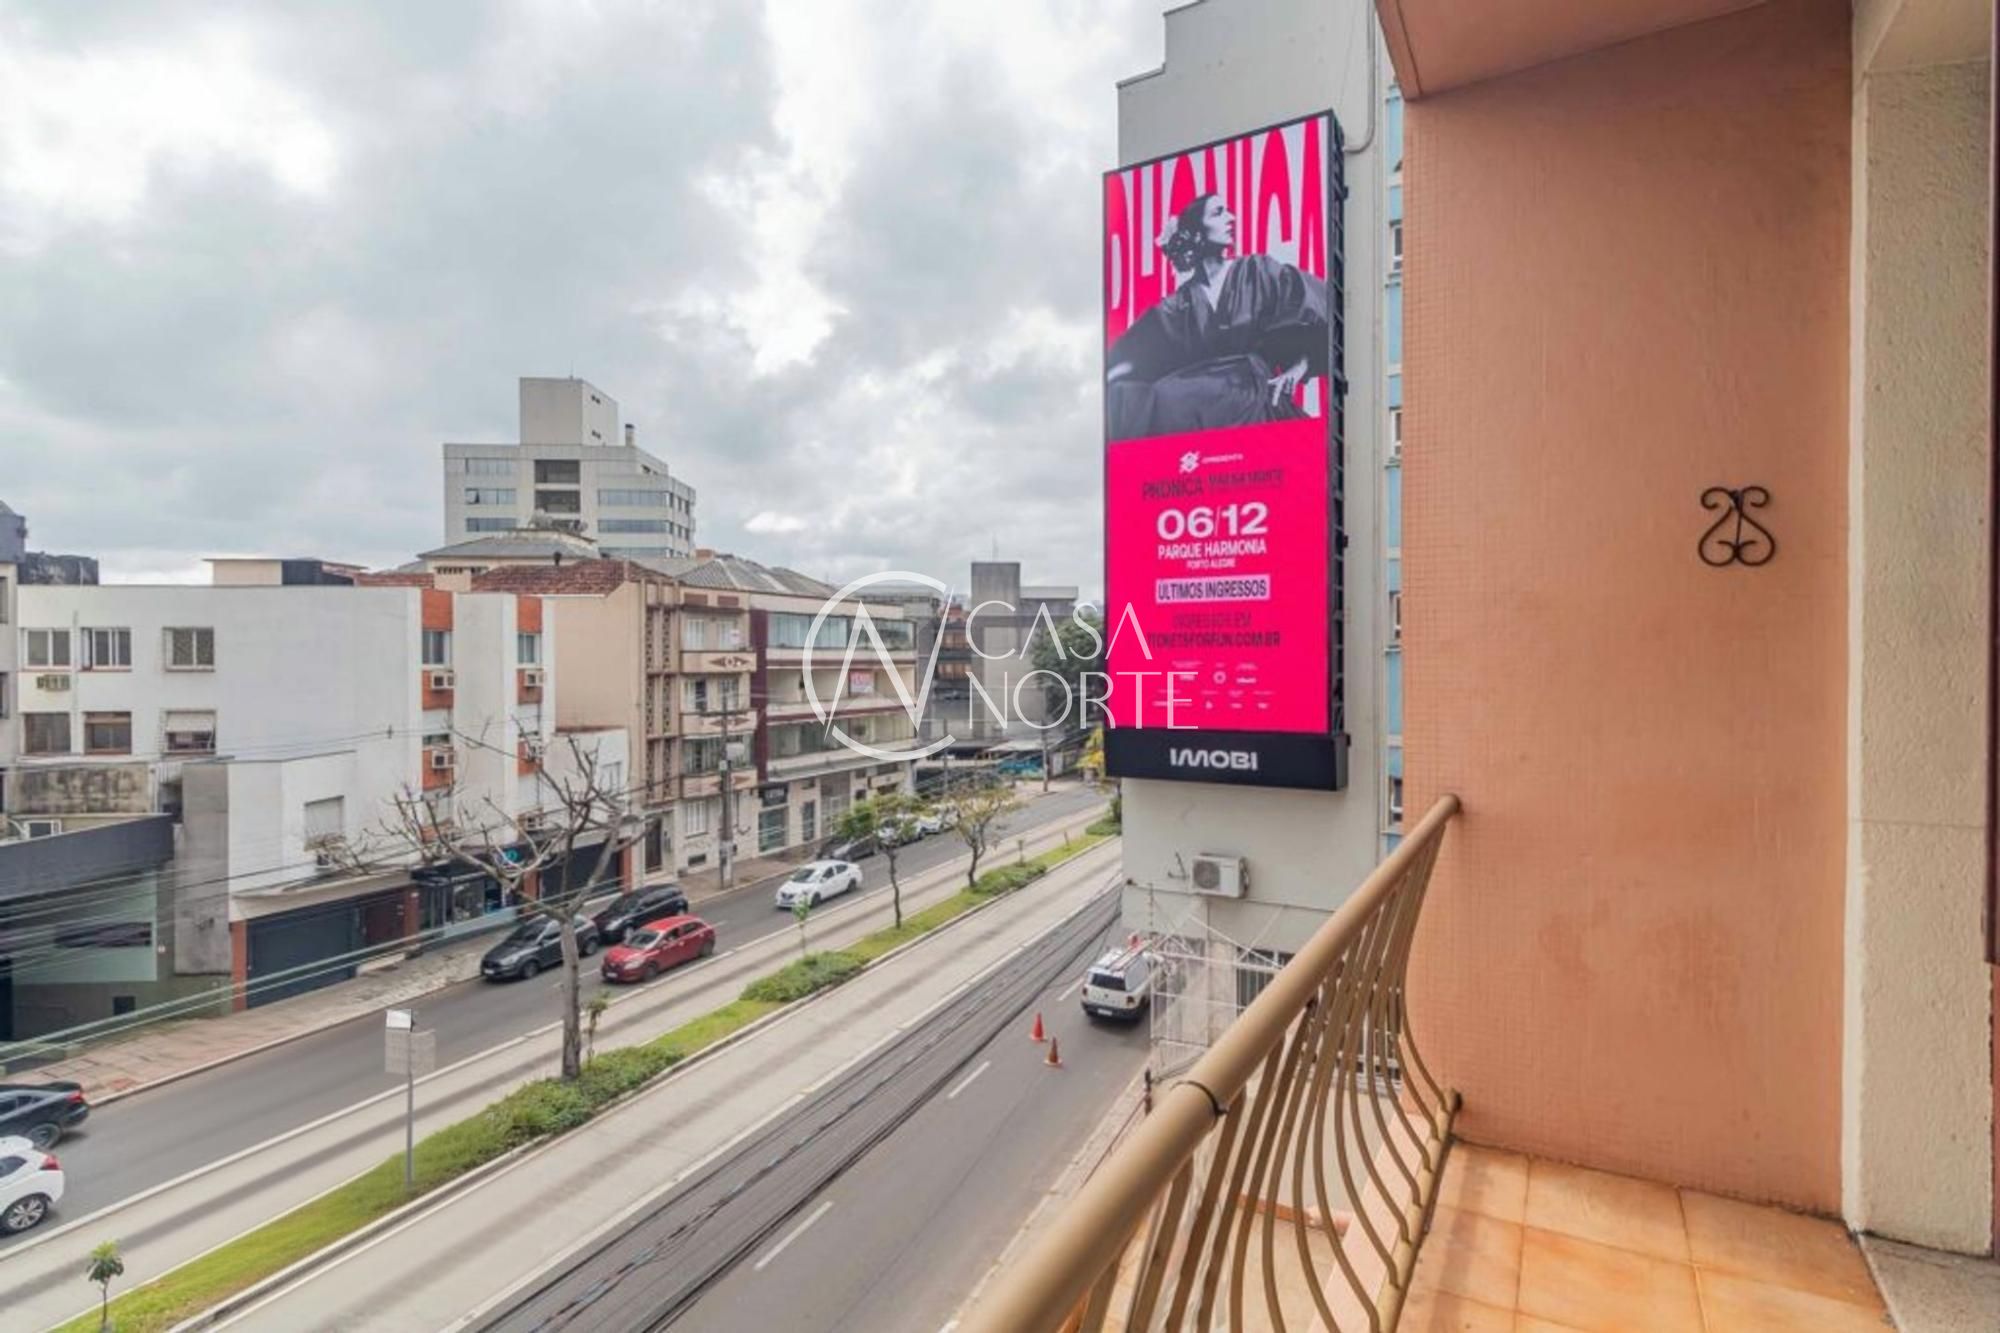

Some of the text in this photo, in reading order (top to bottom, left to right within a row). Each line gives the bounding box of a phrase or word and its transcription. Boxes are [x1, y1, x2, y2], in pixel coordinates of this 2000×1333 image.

[1157, 502, 1268, 539] 06/12
[1158, 539, 1267, 559] PARQUE HARMONIA
[1205, 579, 1266, 598] INGRESSOS
[1169, 748, 1258, 770] IMOBI
